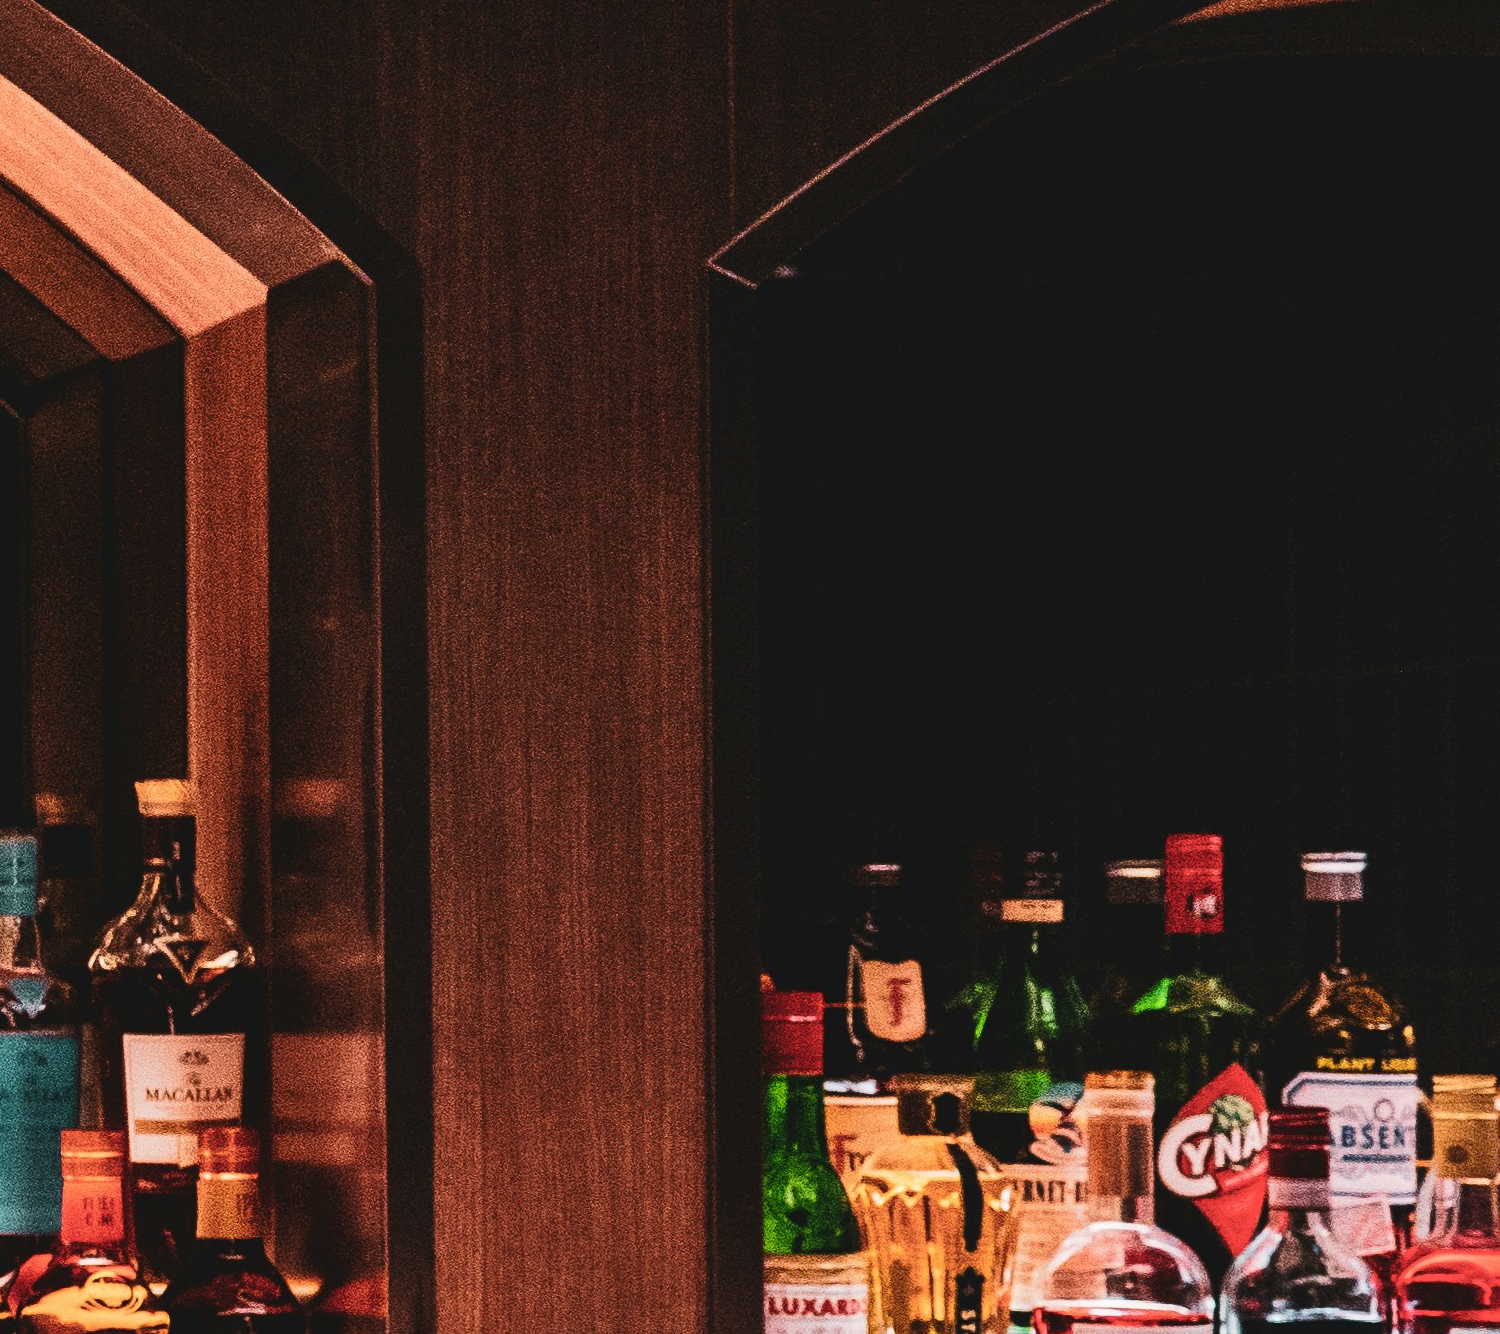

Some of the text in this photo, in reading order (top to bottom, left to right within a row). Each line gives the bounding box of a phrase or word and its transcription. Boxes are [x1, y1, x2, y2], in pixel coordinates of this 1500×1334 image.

[145, 1085, 233, 1103] MACALLAN
[1329, 1124, 1407, 1149] BSEN
[1157, 1110, 1269, 1198] CYNA
[768, 1296, 862, 1317] LUXARD
